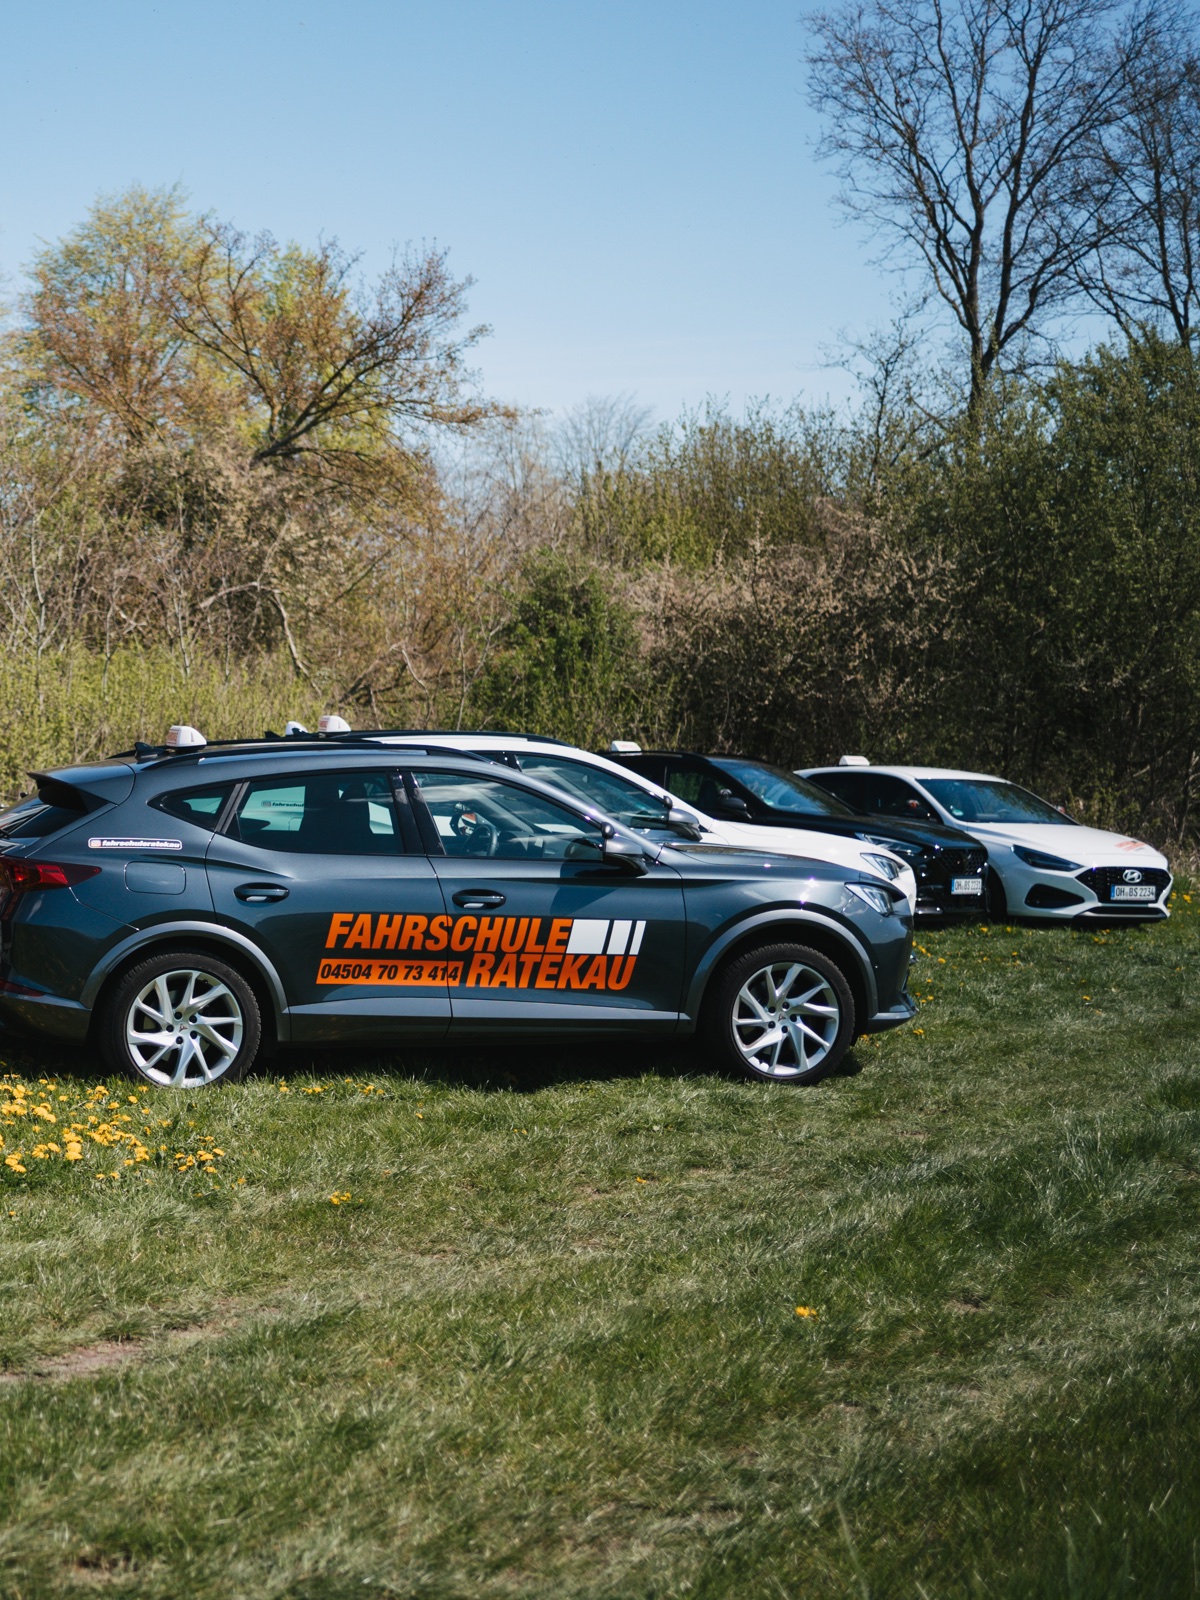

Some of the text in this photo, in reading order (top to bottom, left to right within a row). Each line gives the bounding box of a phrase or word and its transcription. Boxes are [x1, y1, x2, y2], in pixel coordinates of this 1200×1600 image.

[102, 839, 180, 848] fahrschuleratekau
[1115, 887, 1155, 897] OH BS 2234
[325, 913, 574, 953] FAHRSCHULE
[320, 963, 460, 982] 04504 70 73 414
[465, 953, 637, 990] RATEKAU
